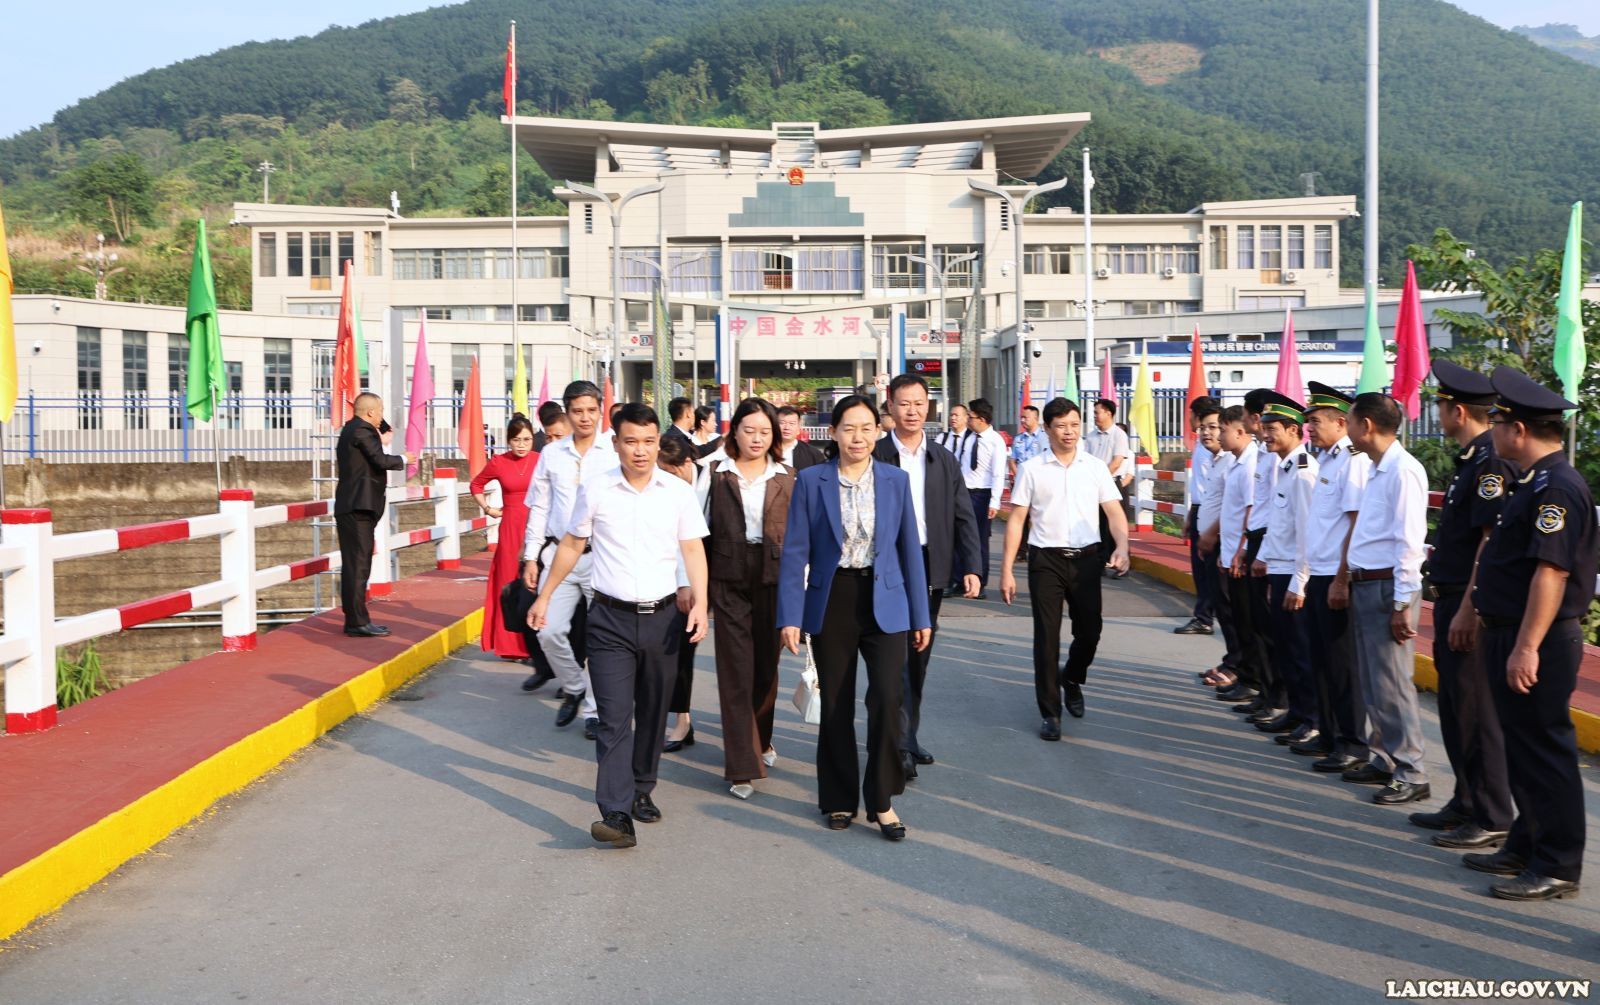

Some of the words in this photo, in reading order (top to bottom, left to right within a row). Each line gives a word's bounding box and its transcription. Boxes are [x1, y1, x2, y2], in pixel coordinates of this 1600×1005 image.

[729, 315, 861, 336] 中国金水河
[1254, 342, 1280, 351] CHINA
